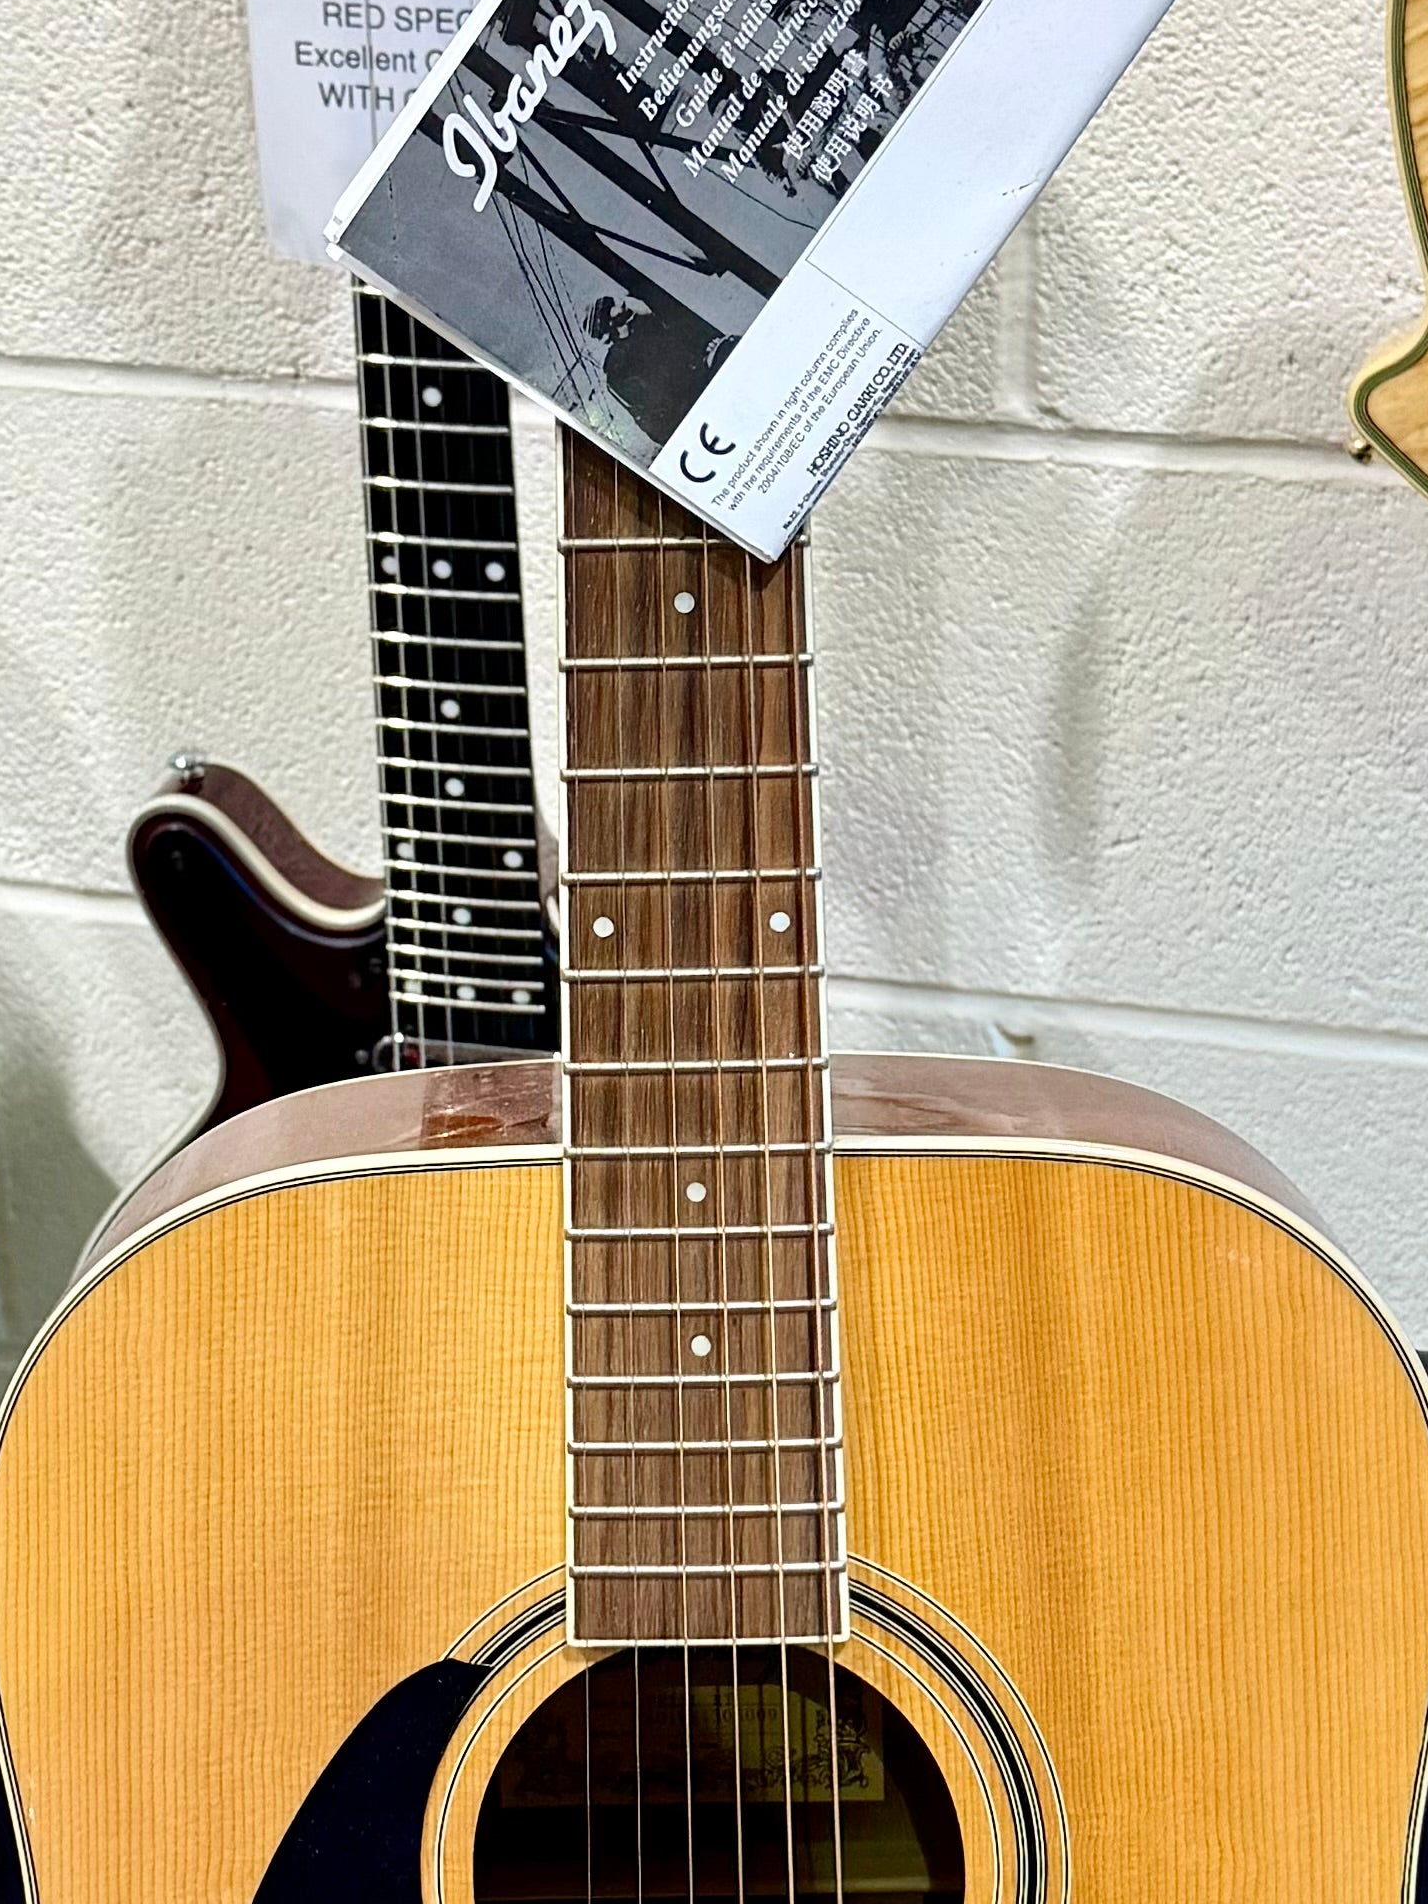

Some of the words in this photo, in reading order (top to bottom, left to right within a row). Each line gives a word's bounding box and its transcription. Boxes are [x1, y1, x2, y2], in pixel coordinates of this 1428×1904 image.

[322, 1, 386, 30] RED
[294, 40, 417, 74] Excellent
[318, 81, 395, 113] WITH
[674, 66, 723, 128] Guide
[682, 93, 745, 178] Manual
[740, 69, 763, 99] de
[720, 94, 789, 183] Manuale
[784, 67, 805, 96] di
[816, 357, 840, 386] EMC
[820, 357, 860, 406] European
[709, 486, 730, 506] The
[726, 449, 757, 490] product
[752, 418, 780, 452] shown
[782, 385, 803, 410] right
[799, 351, 828, 387] column
[805, 420, 851, 478] HOSHINO
